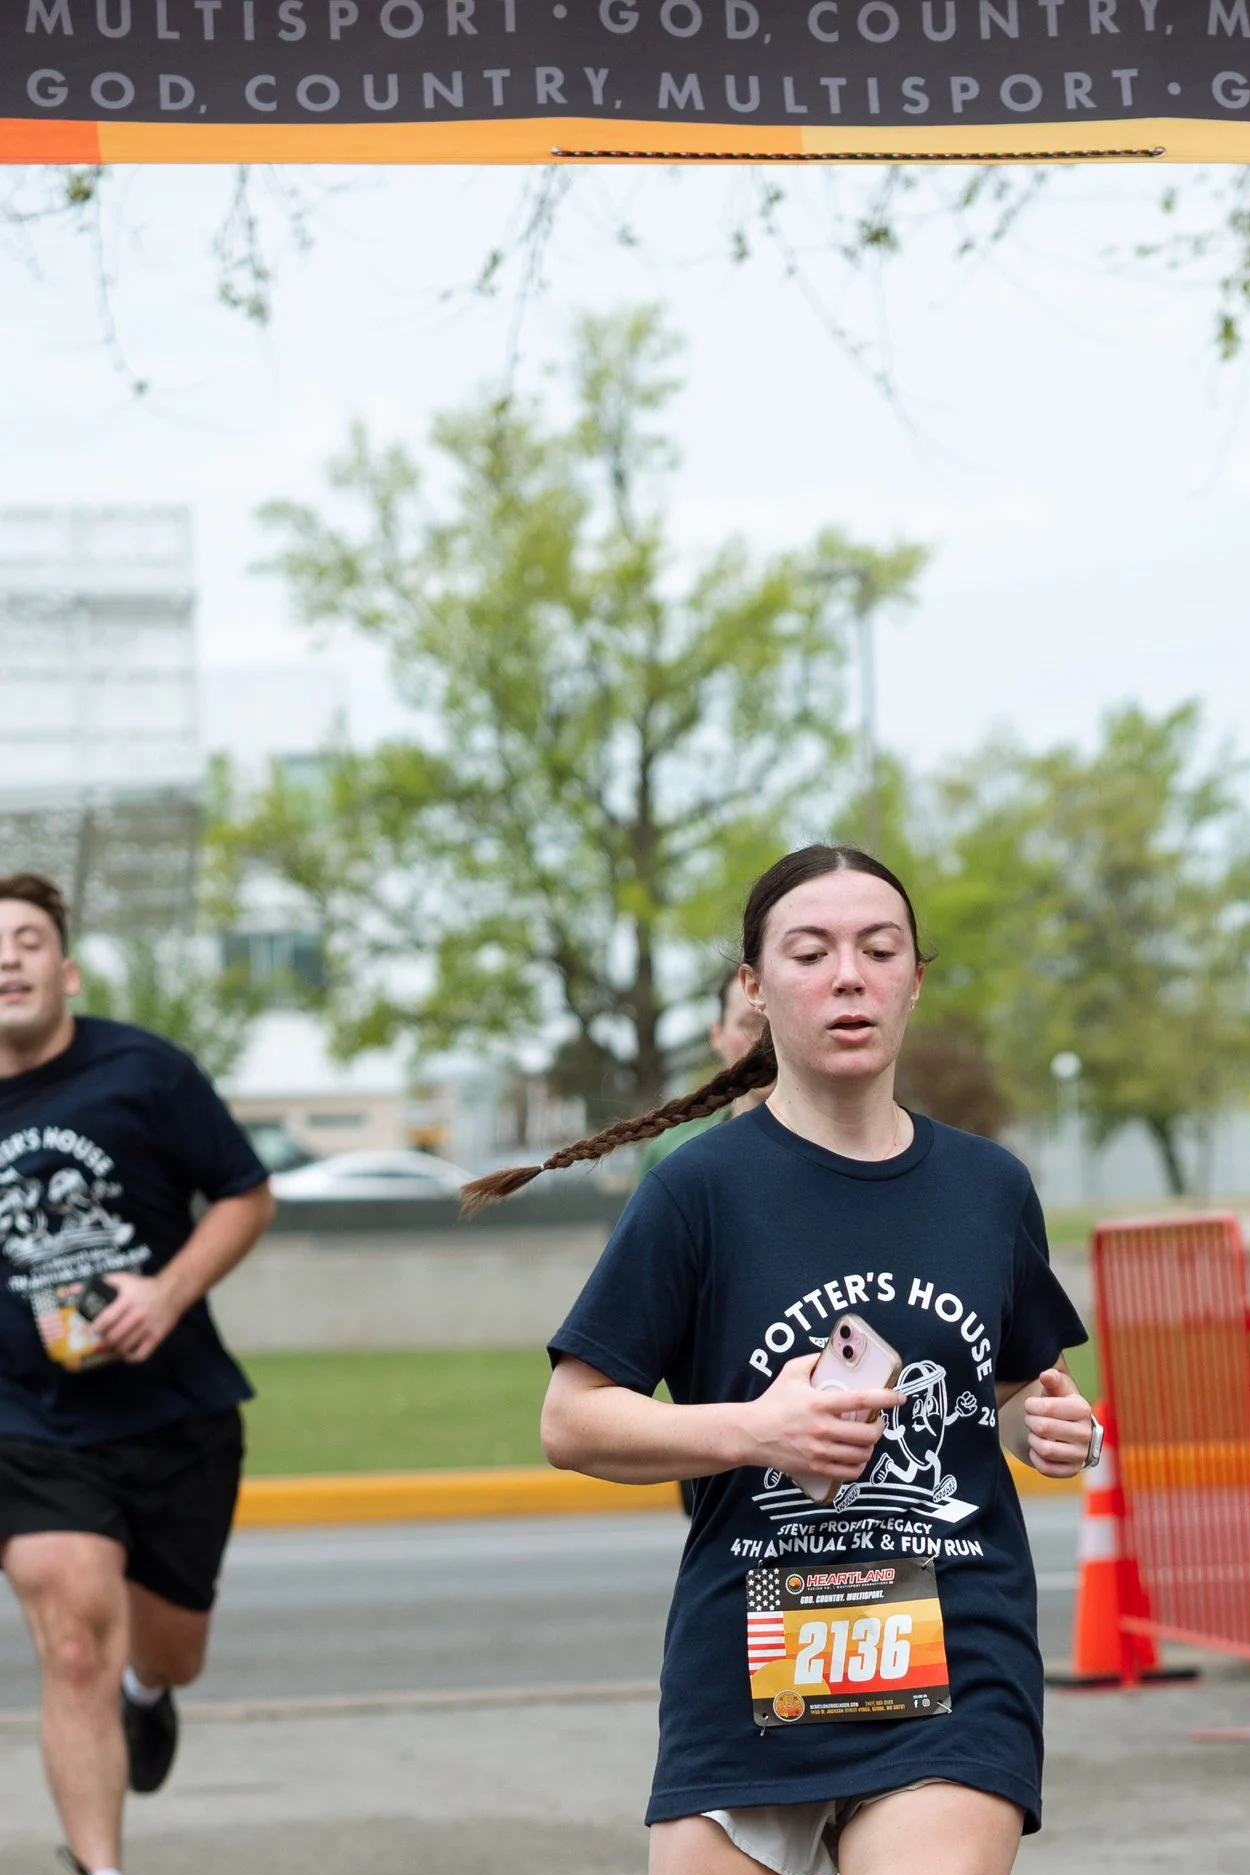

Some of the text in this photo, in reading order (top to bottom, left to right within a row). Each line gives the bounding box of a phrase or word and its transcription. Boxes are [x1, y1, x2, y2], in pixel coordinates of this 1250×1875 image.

[25, 0, 520, 41] MULTISPORT
[599, 0, 771, 44] GOD,
[808, 0, 1174, 43] COUNTRY,
[26, 68, 208, 114] GOD,
[244, 66, 623, 113] COUNTRY,
[657, 68, 1140, 115] MULTISPORT
[748, 1271, 993, 1382] POTTER'S HOUSE
[977, 1406, 996, 1428] 26
[777, 1523, 815, 1536] STEVE
[880, 1517, 933, 1535] LEGACY
[730, 1531, 984, 1558] 4TH ANNUAL 5K & FUN RUN
[806, 1568, 896, 1587] HEARTLAND
[793, 1614, 912, 1685] 2136
